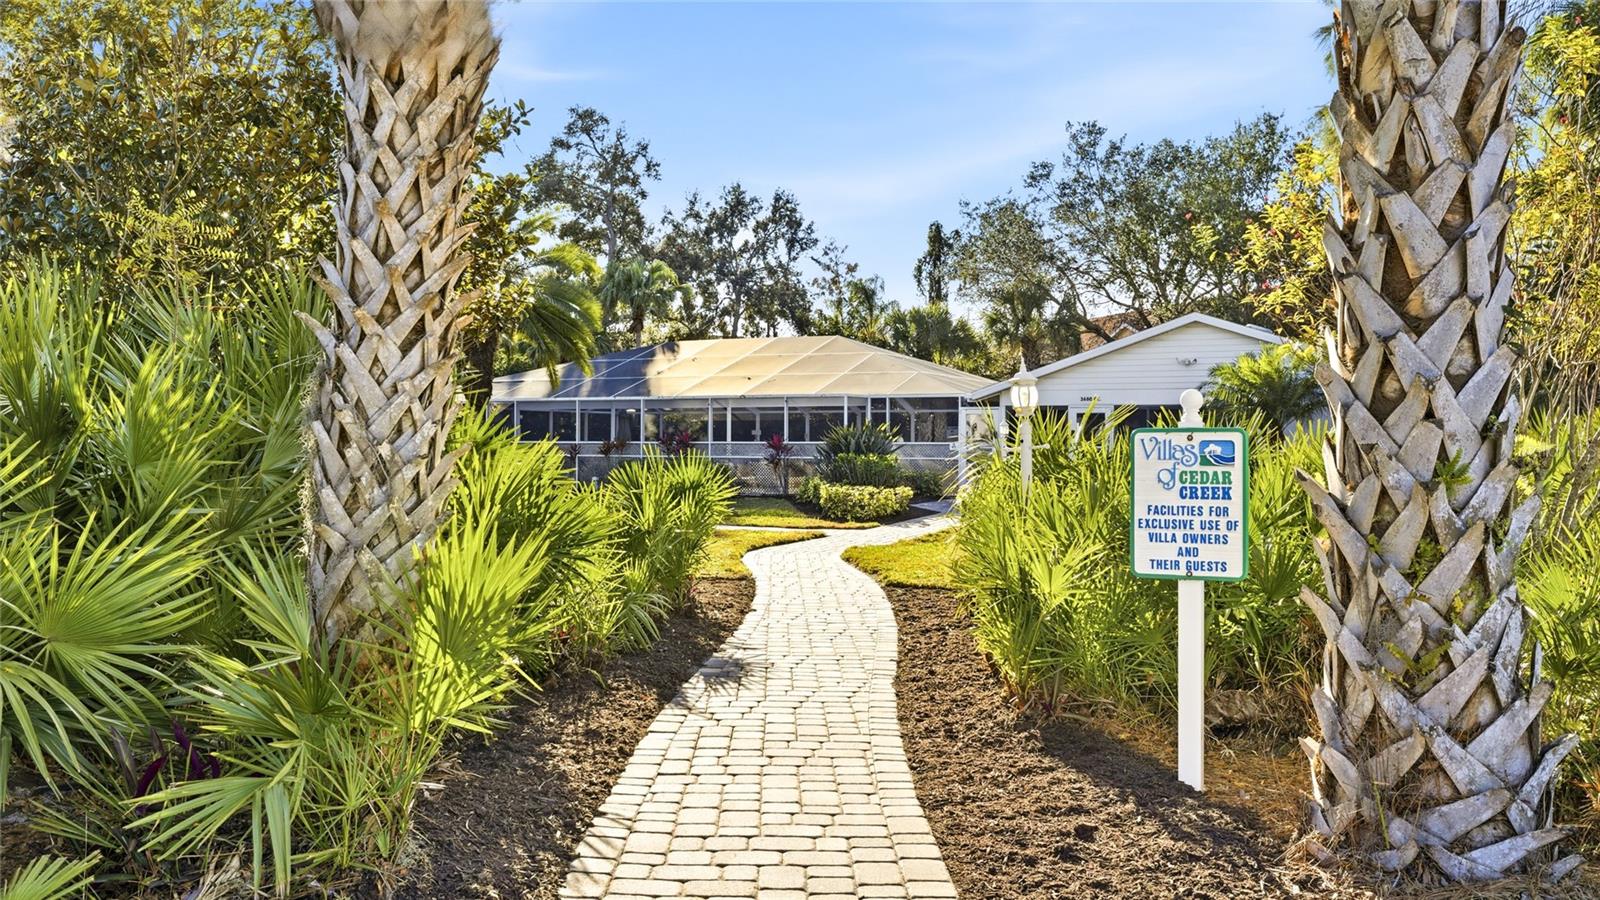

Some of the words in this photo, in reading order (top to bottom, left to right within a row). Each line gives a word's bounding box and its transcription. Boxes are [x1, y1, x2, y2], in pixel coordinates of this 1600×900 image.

[1140, 436, 1199, 467] Villas
[1157, 462, 1180, 490] of
[1179, 470, 1233, 485] CEDAR
[1179, 486, 1232, 501] CREEK
[1147, 505, 1204, 516] FACILITIES
[1209, 506, 1229, 517] FOR
[1138, 518, 1194, 530] EXCLUSIVE
[1200, 520, 1220, 531] USE
[1226, 520, 1239, 531] OF
[1148, 532, 1177, 543] VILLA
[1182, 533, 1229, 545] OWNERS
[1177, 546, 1199, 558] AND
[1149, 559, 1180, 570] THEIR
[1186, 560, 1227, 572] GUESTS
